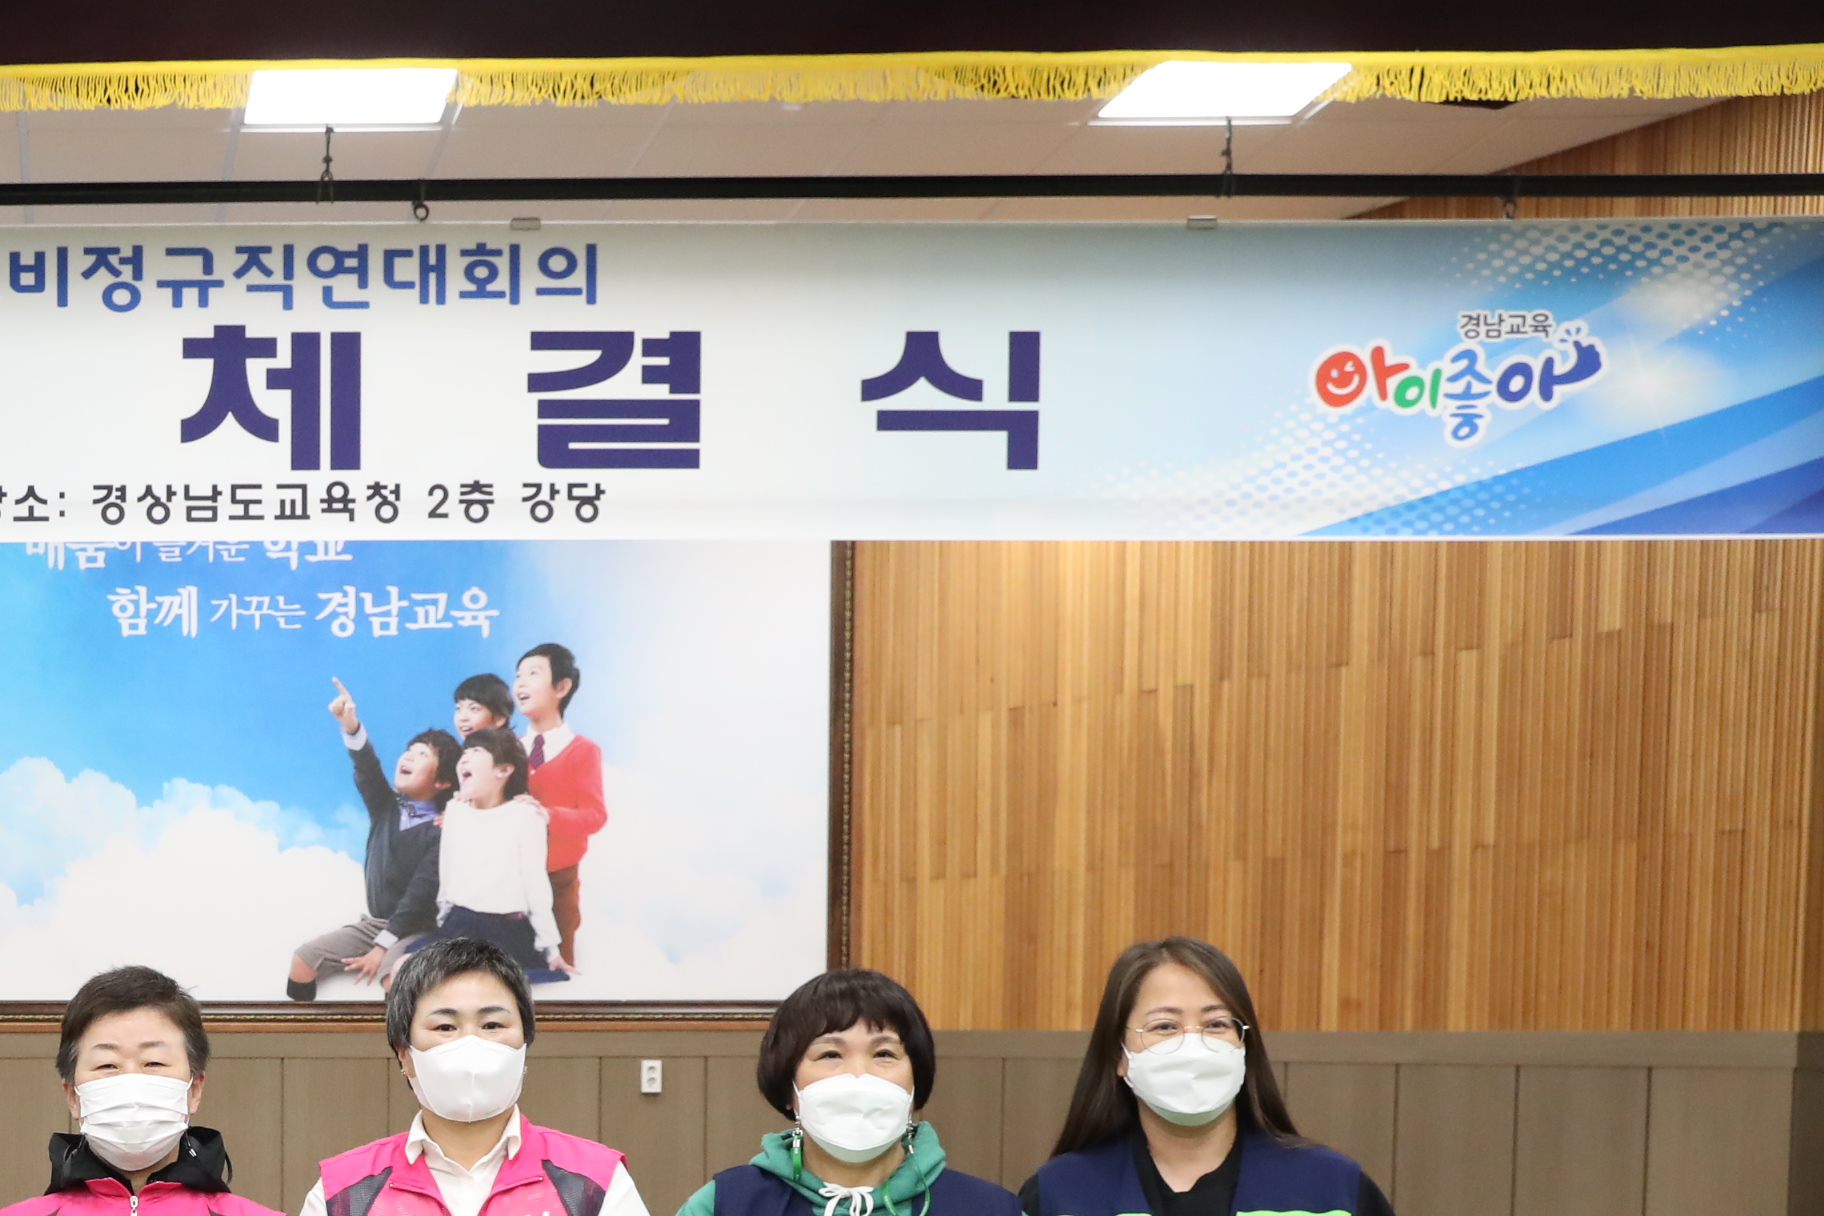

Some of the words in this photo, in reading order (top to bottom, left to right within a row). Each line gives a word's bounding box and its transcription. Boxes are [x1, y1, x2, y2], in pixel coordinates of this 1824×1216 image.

[1460, 313, 1552, 339] 경남교육
[92, 482, 402, 525] 경상남도교육청
[428, 481, 495, 524] 2층
[522, 483, 606, 523] 강당
[107, 585, 198, 638] 함께
[210, 593, 306, 630] 가꾸는
[315, 585, 500, 638] 경남교육
